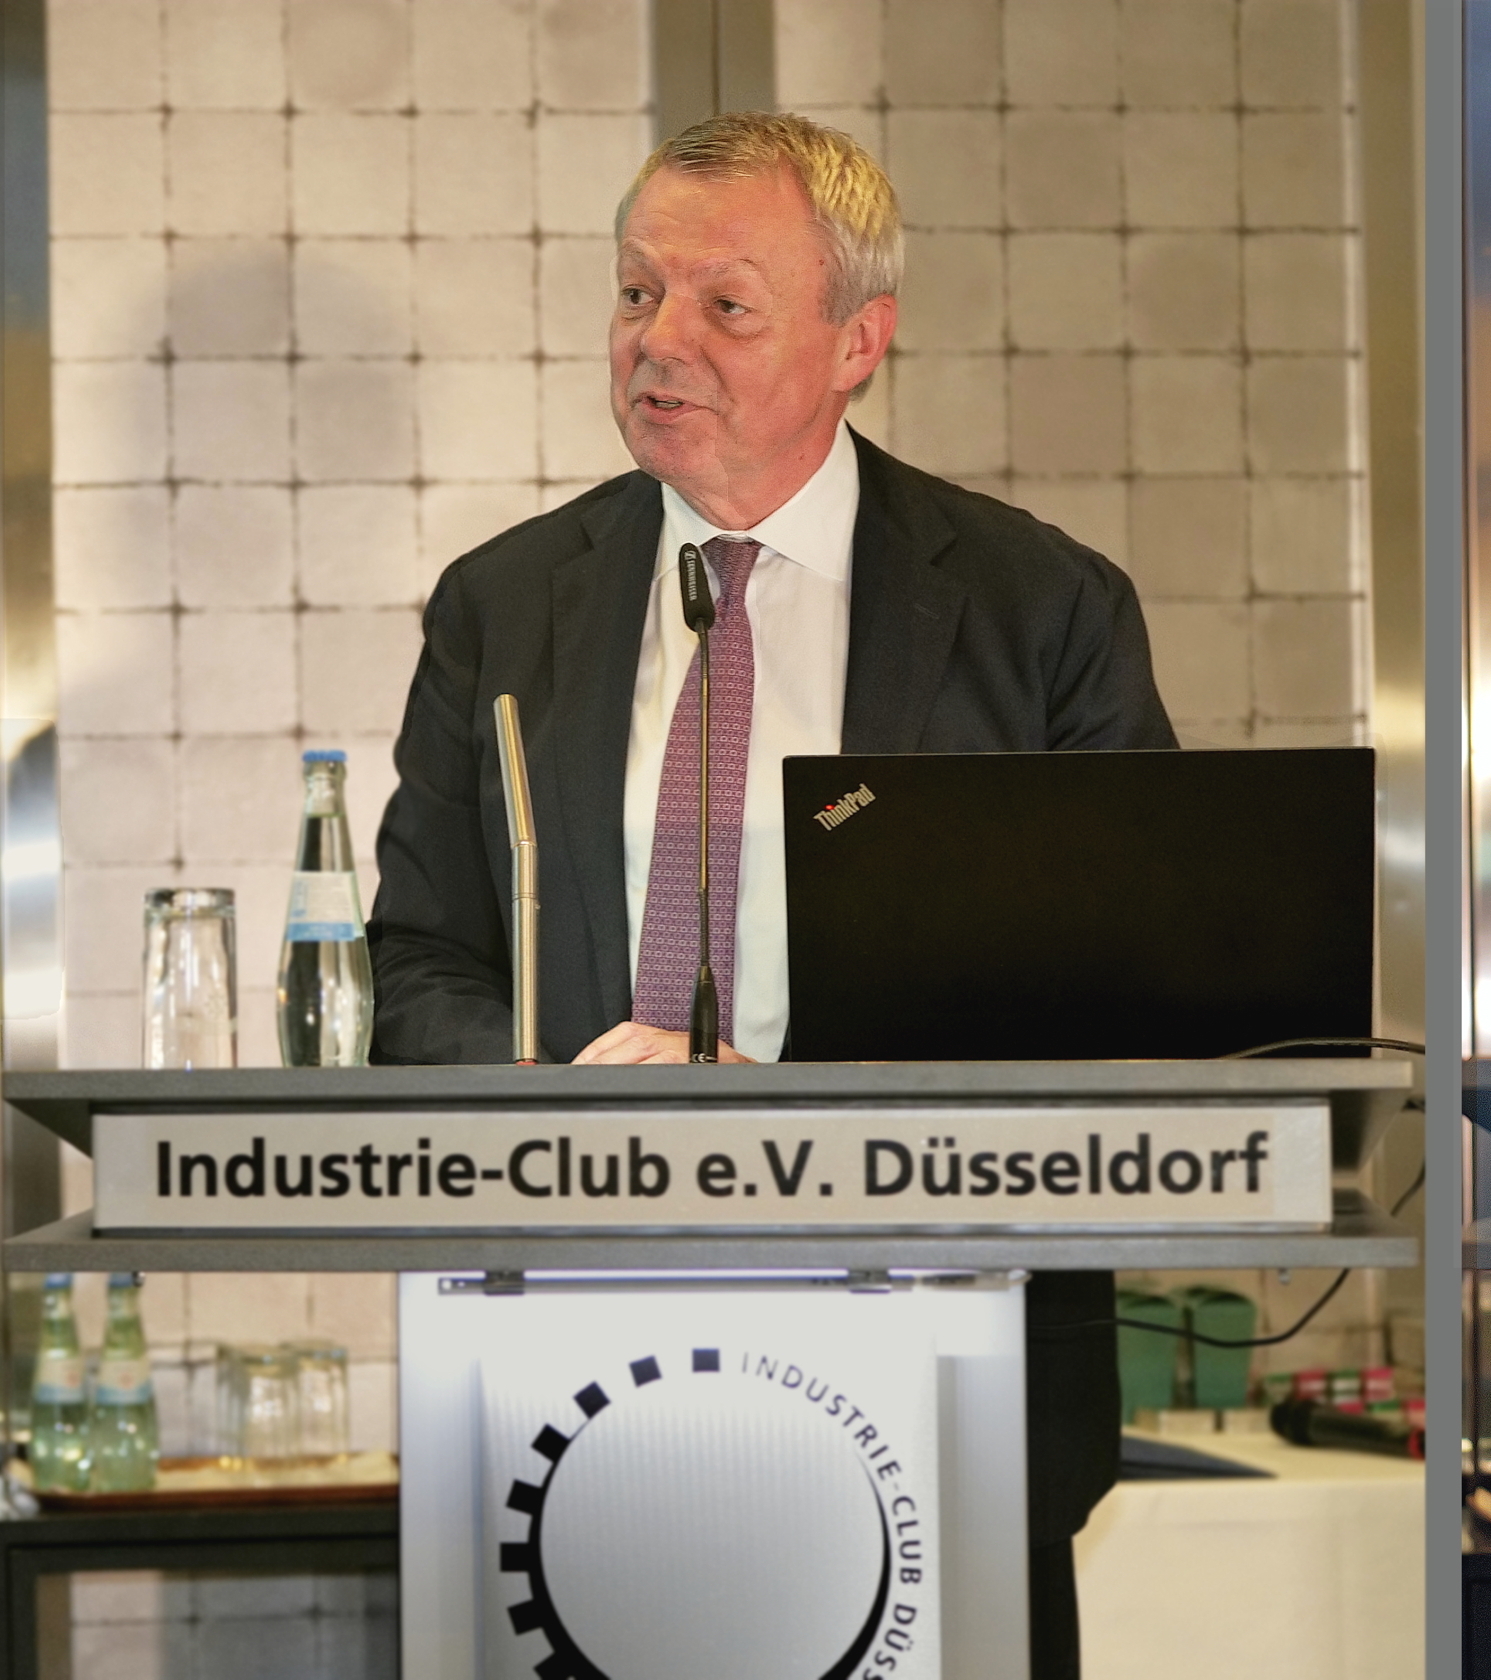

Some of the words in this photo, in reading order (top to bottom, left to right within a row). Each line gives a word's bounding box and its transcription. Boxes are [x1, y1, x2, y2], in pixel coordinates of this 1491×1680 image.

[813, 783, 877, 831] ThinkPad
[156, 1135, 671, 1199] Industrie-Club
[696, 1139, 833, 1198] e.V.
[864, 1131, 1269, 1197] Düsseldorf
[741, 1351, 923, 1585] INDUSTRIE-CLUB
